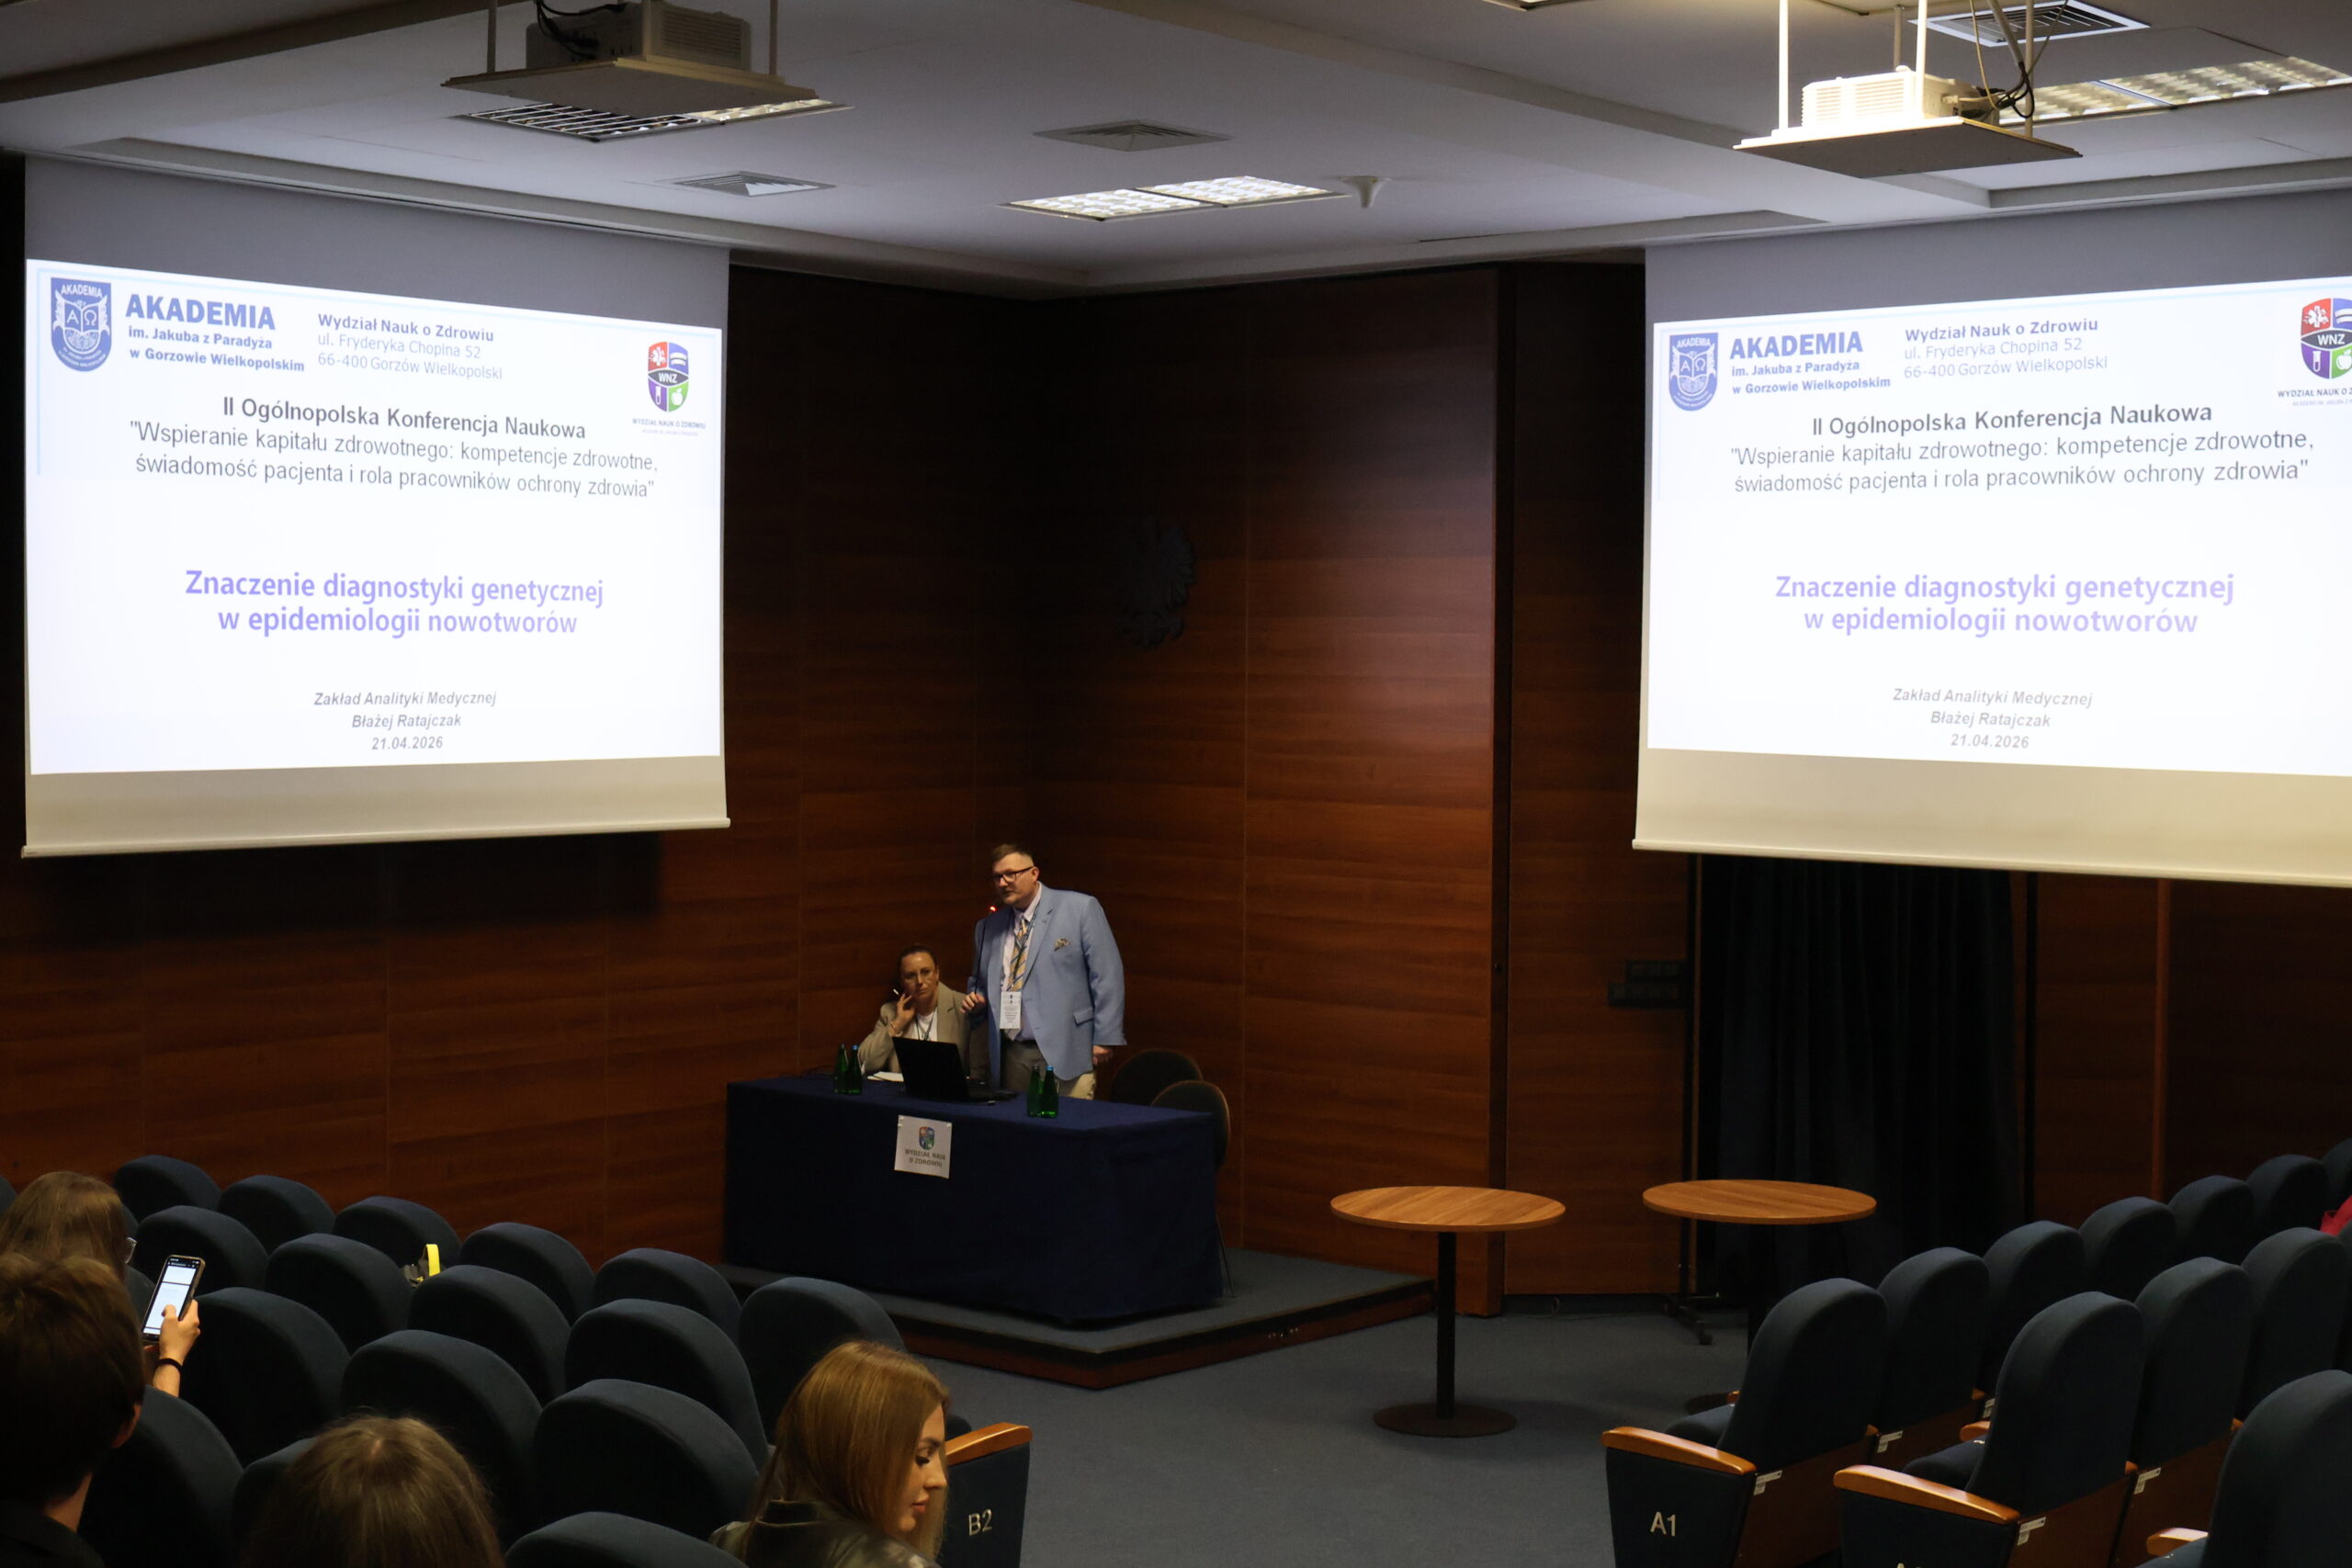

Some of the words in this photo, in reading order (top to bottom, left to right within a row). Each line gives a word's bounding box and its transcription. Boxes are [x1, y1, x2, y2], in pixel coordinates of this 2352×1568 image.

[61, 284, 103, 299] AKADEMIA
[126, 294, 276, 330] AKADEMIA
[129, 325, 148, 338] im.
[153, 328, 199, 343] Jakuba
[203, 334, 209, 344] z
[213, 333, 272, 350] Paradyża
[318, 313, 378, 331] Wydział
[381, 320, 418, 334] Nauk
[423, 326, 431, 336] o
[435, 324, 493, 342] Zdrowiu
[1905, 325, 1966, 344] Wydział
[1971, 323, 2010, 337] Nauk
[2016, 325, 2024, 334] o
[2030, 318, 2098, 333] Zdrowiu
[2317, 333, 2346, 345] WNZ
[318, 333, 334, 345] ul.
[339, 333, 404, 353] Fryderyka
[409, 340, 460, 357] Chopina
[465, 345, 481, 359] 52
[1677, 337, 1711, 348] AKADEMIA
[1730, 331, 1863, 359] AKADEMIA
[1905, 346, 1920, 359] ul.
[1926, 343, 1996, 360] Fryderyka
[2000, 340, 2058, 355] Chopina
[2064, 337, 2082, 351] 52
[130, 349, 140, 358] w
[145, 348, 207, 364] Gorzowie
[210, 353, 304, 372] Wielkopolskim
[318, 353, 368, 368] 66-400
[370, 356, 419, 373] Gorzów
[424, 361, 502, 380] Wielkopolski
[1732, 366, 1748, 377] im.
[1752, 364, 1792, 375] Jakuba
[1805, 361, 1860, 373] Paradyża
[1905, 364, 1955, 378] 66-400
[1958, 360, 2011, 376] Gorzów
[2016, 355, 2108, 373] Wielkopolski
[659, 372, 678, 384] WNZ
[1746, 381, 1798, 393] Gorzowie
[1802, 377, 1891, 391] Wielkopolskim
[224, 397, 233, 415] II
[242, 399, 379, 426] Ogólnopolska
[388, 408, 498, 437] Konferencja
[506, 416, 585, 438] Naukowa
[1814, 418, 1822, 435] II
[1830, 412, 1965, 438] Ogólnopolska
[1975, 407, 2101, 430] Konferencja
[2111, 404, 2211, 424] Naukowa
[130, 421, 248, 447] "Wspieranie
[256, 429, 326, 454] kapitału
[334, 434, 453, 462] zdrowotnego:
[461, 441, 567, 468] kompetencje
[573, 449, 657, 472] zdrowotne,
[1731, 446, 1835, 468] "Wspieranie
[1843, 442, 1911, 466] kapitału
[1919, 441, 2047, 461] zdrowotnego:
[2057, 433, 2188, 458] kompetencje
[2195, 431, 2312, 451] zdrowotne,
[136, 453, 256, 478] świadomość
[265, 461, 343, 485] pacjenta
[350, 464, 353, 483] i
[360, 466, 391, 484] rola
[400, 471, 510, 491] pracowników
[517, 474, 581, 498] ochrony
[588, 478, 654, 497] zdrowia"
[1735, 473, 1842, 491] świadomość
[1849, 471, 1927, 494] pacjenta
[1933, 469, 1938, 487] i
[1945, 468, 1978, 487] rola
[1987, 466, 2115, 491] pracowników
[2124, 464, 2204, 486] ochrony
[2214, 459, 2308, 480] zdrowia"
[186, 570, 315, 596] Znaczenie
[323, 572, 463, 605] diagnostyki
[471, 580, 603, 609] genetycznej
[1776, 575, 1896, 598] Znaczenie
[1905, 574, 2055, 605] diagnostyki
[2065, 573, 2233, 606] genetycznej
[218, 613, 240, 629] w
[249, 606, 419, 638] epidemiologii
[429, 610, 577, 633] nowotworów
[1804, 614, 1824, 628] w
[1832, 606, 2006, 637] epidemiologii
[2016, 608, 2198, 632] nowotworów
[314, 693, 361, 705] Zakład
[364, 692, 424, 708] Analityki
[427, 691, 496, 707] Medycznej
[1893, 688, 1940, 701] Zakład
[1943, 689, 2008, 706] Analityki
[2012, 691, 2093, 709] Medycznej
[352, 714, 393, 730] Błażej
[397, 714, 461, 730] Ratajczak
[1930, 711, 1975, 728] Błażej
[1978, 712, 2051, 729] Ratajczak
[371, 736, 443, 750] 21.04.2026
[1951, 734, 2029, 749] 21.04.2026
[915, 1158, 942, 1167] ZDROWIU
[968, 1509, 992, 1536] B2
[1650, 1511, 1676, 1537] A1
